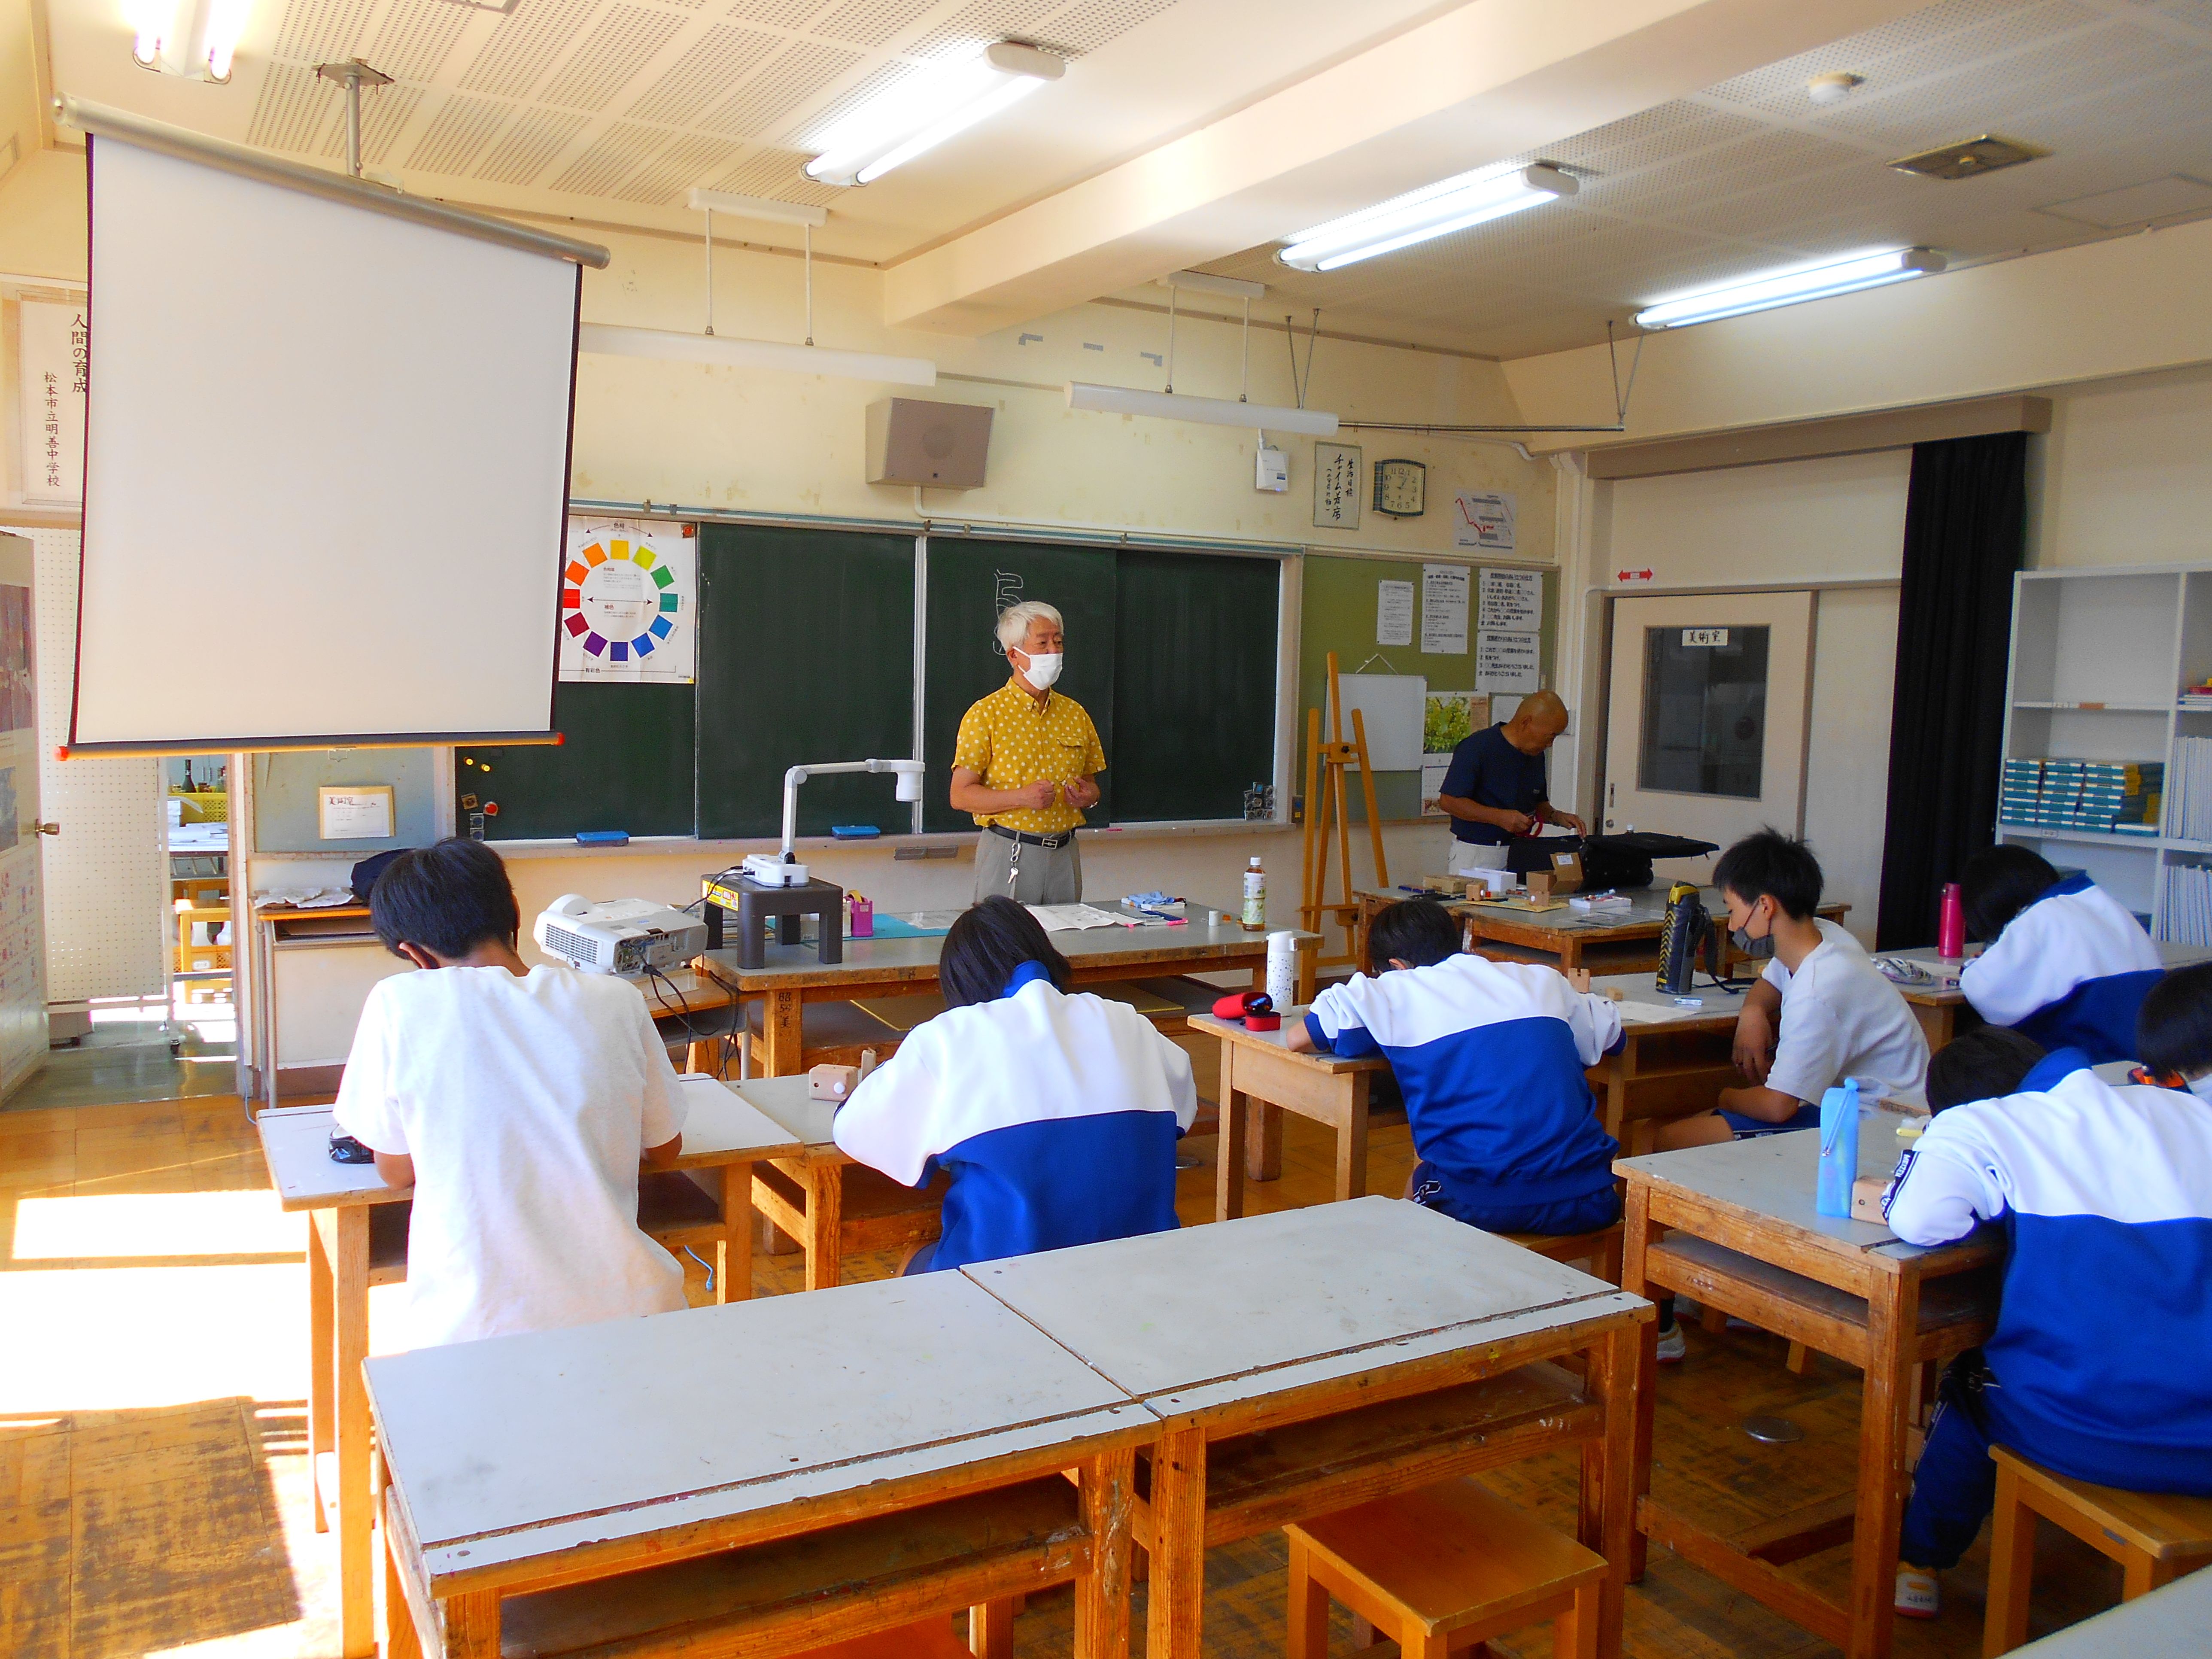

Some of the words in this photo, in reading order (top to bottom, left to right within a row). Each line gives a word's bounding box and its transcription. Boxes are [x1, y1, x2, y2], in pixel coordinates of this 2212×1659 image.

[71, 314, 88, 393] 人間の育成
[44, 371, 60, 487] 松本市立明善中学校
[1332, 453, 1344, 521] チャイム着席
[1689, 630, 1721, 644] 美術室
